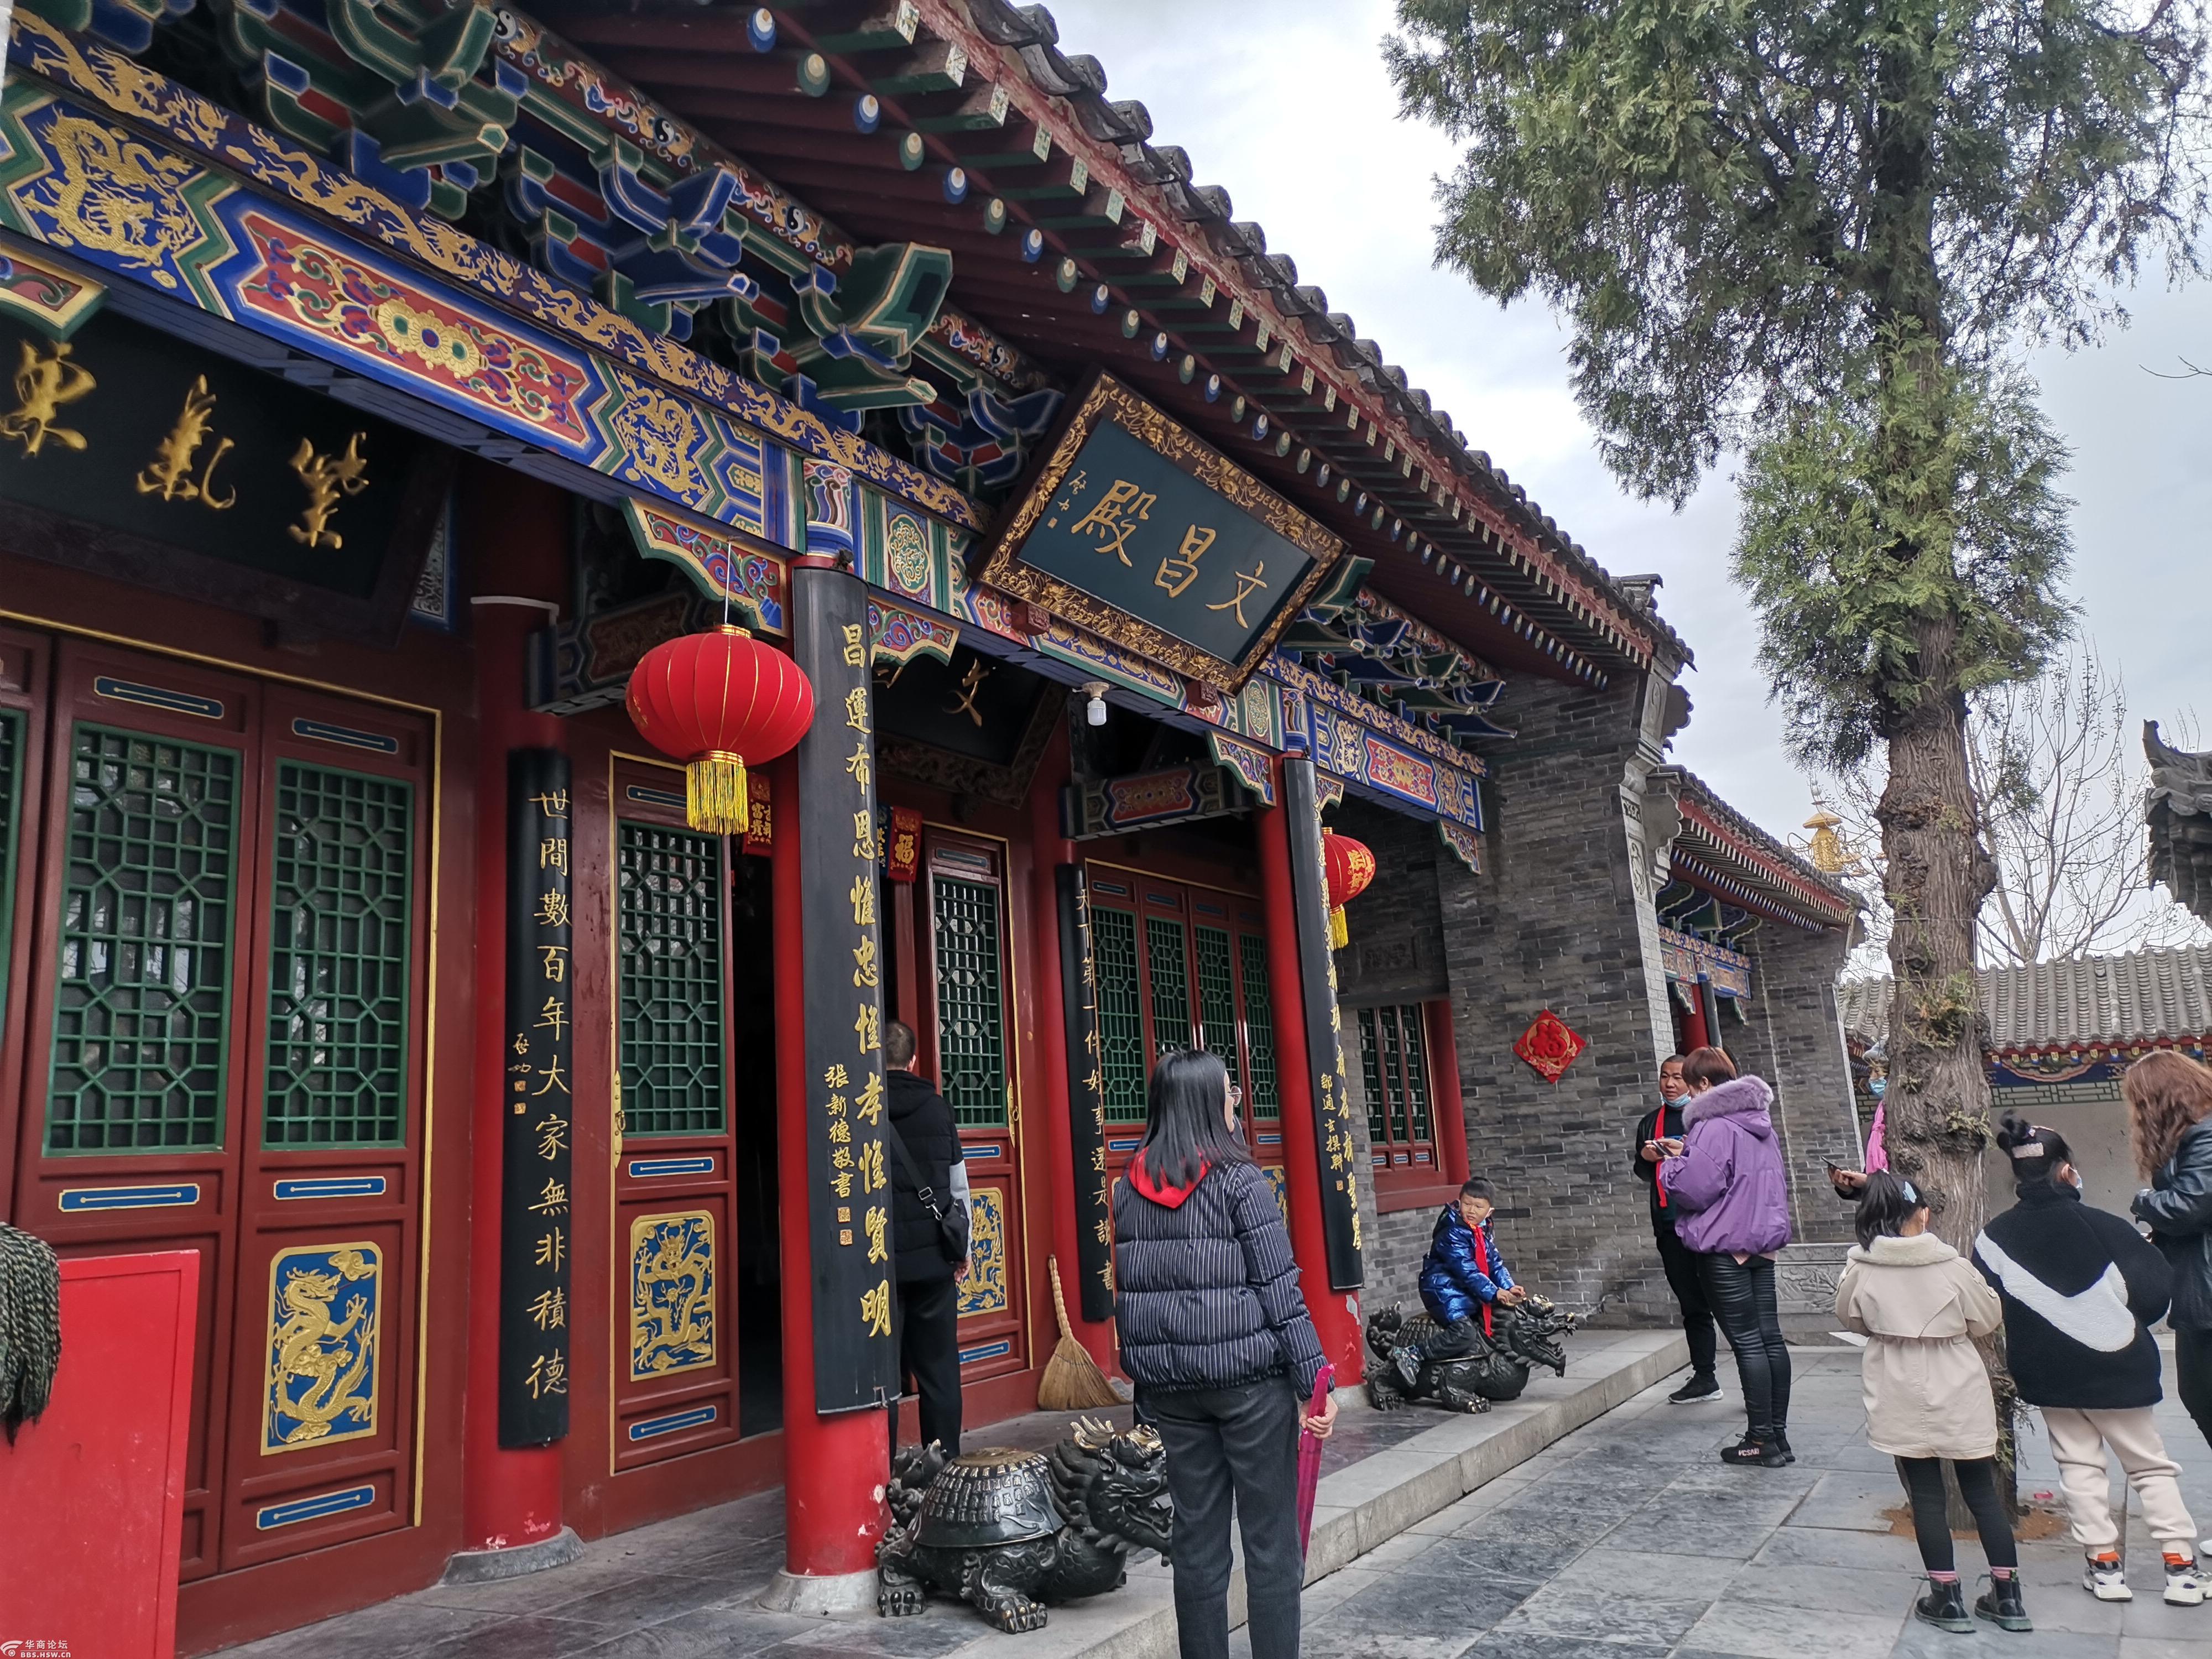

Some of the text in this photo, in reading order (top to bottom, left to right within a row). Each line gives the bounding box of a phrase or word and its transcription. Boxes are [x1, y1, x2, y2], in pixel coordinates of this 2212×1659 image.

[1071, 479, 1267, 629] 文昌殿
[894, 833, 915, 864] 福
[1530, 1021, 1568, 1058] 福
